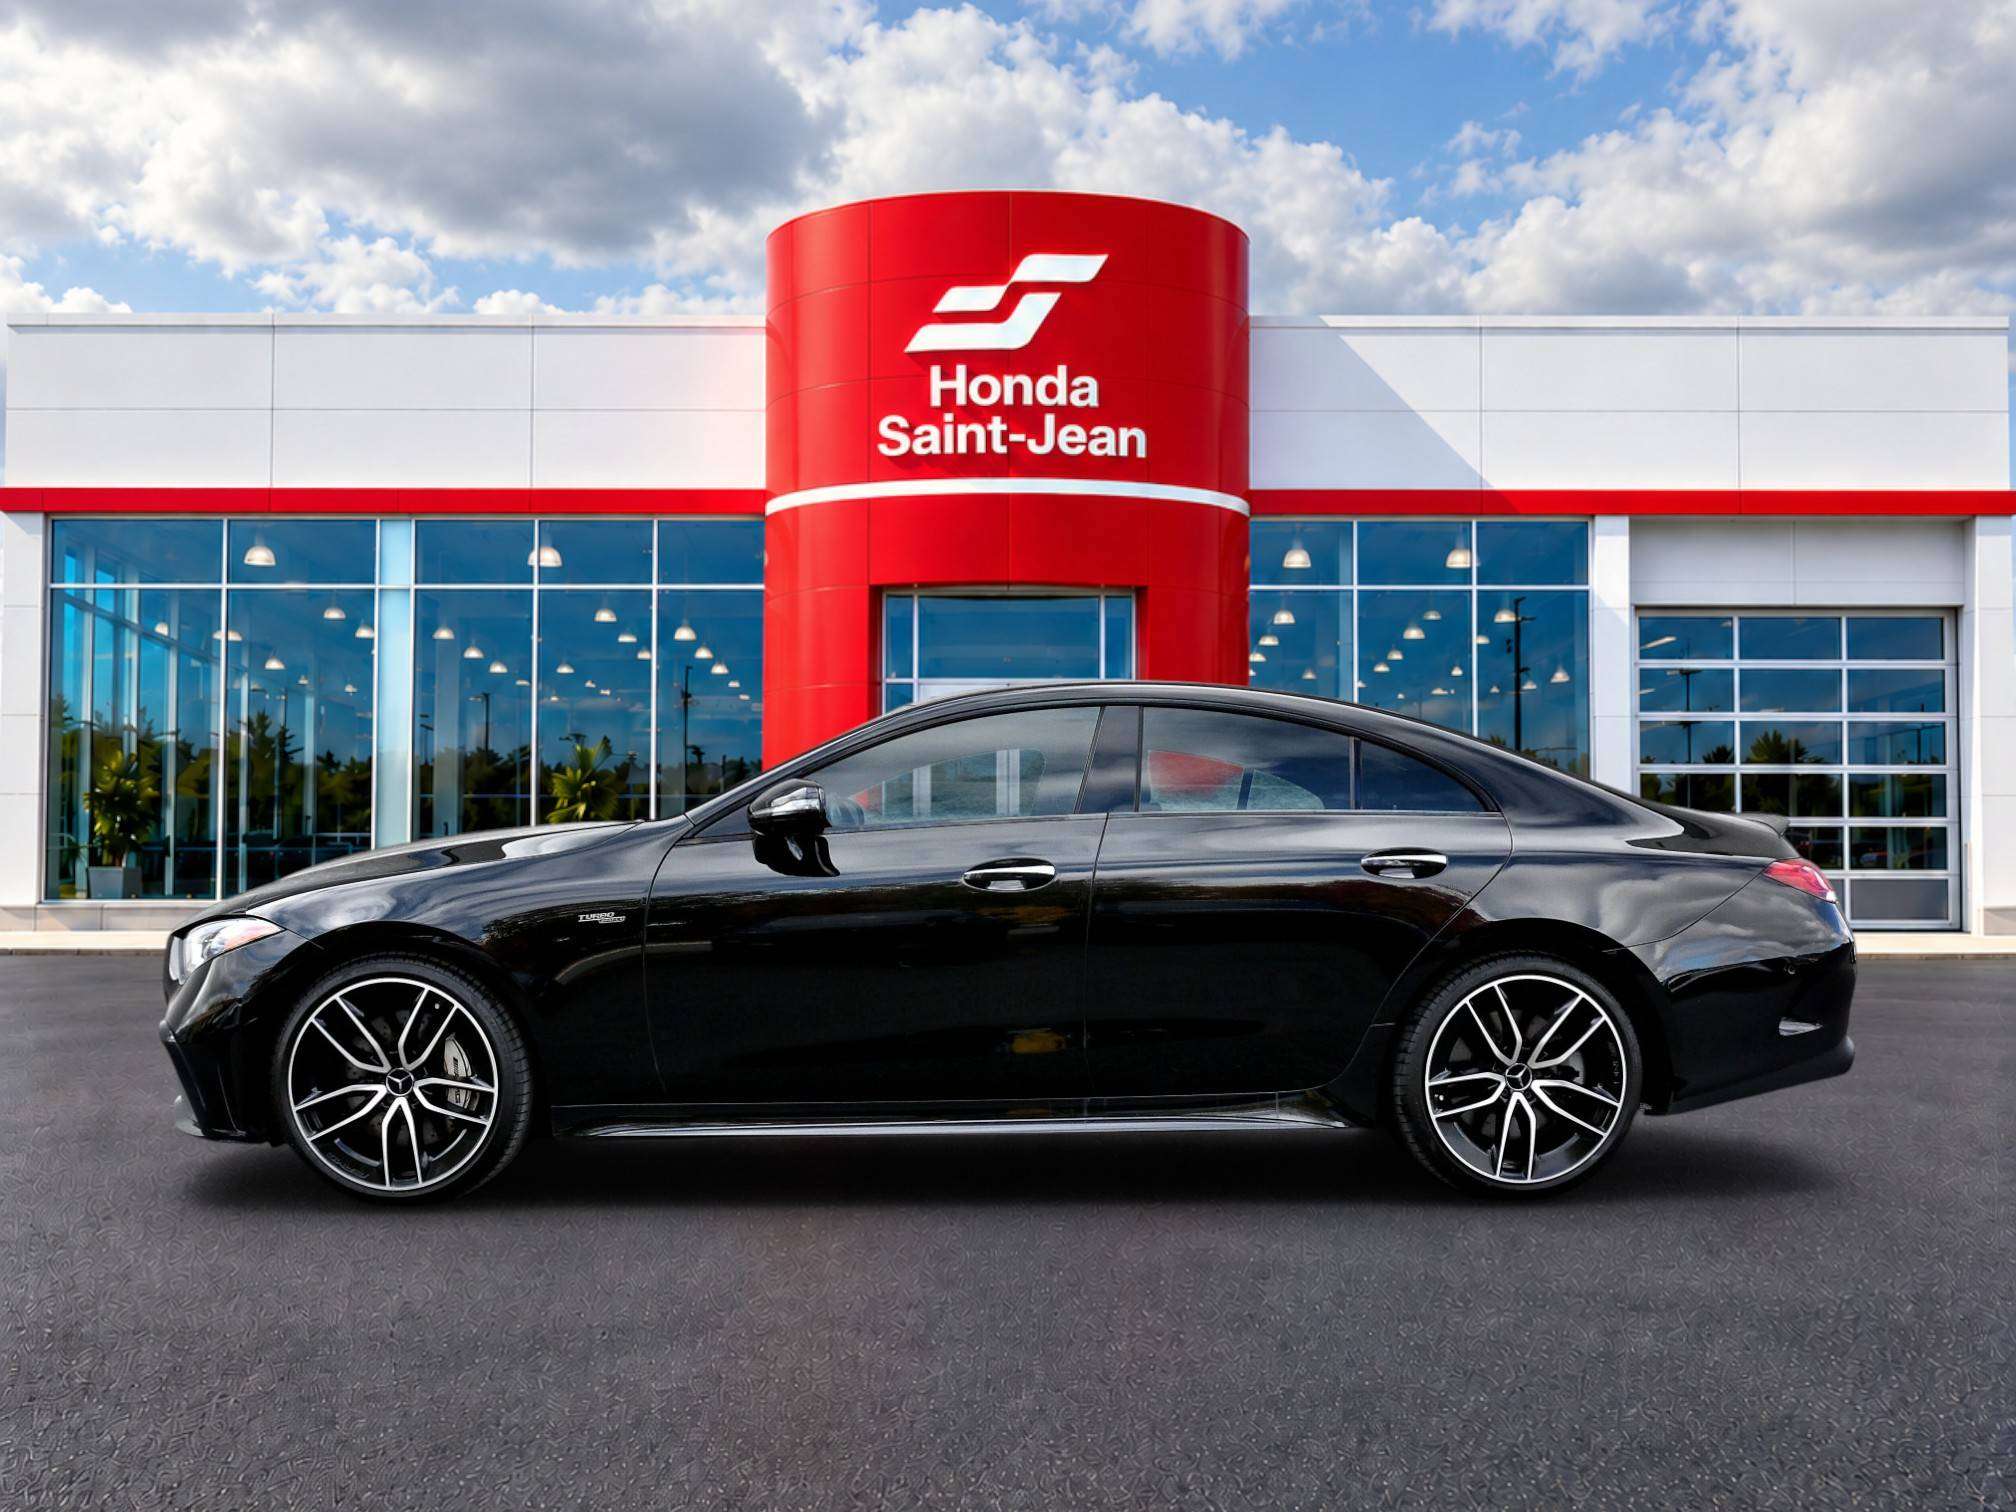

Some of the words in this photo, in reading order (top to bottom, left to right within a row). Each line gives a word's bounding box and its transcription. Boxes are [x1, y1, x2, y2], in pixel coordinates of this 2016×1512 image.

[929, 364, 1100, 407] Honda
[876, 412, 1147, 458] Saint-Jean
[577, 911, 615, 921] TURBO
